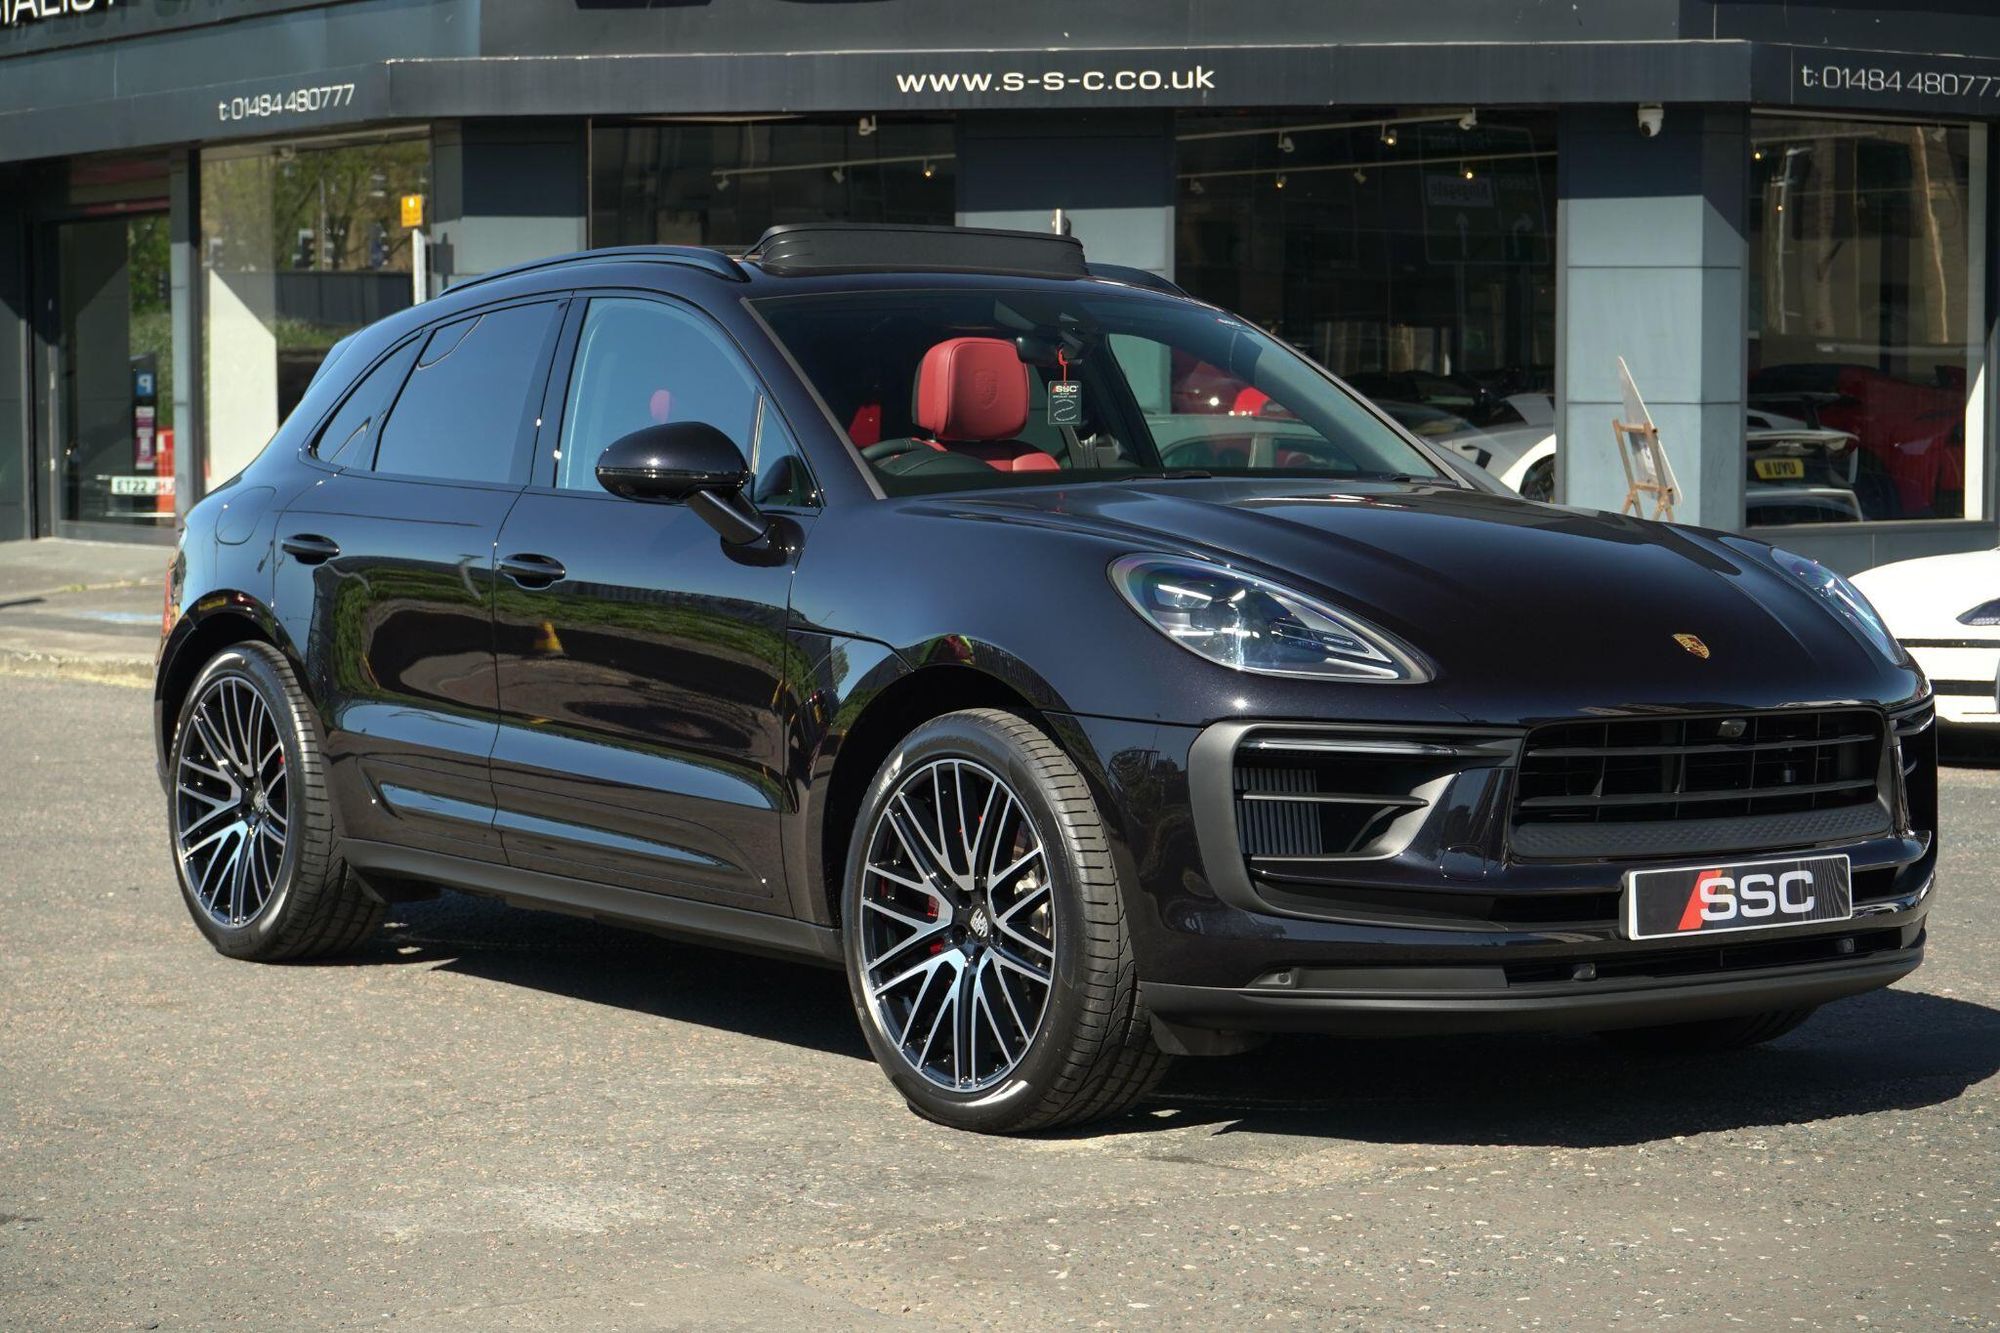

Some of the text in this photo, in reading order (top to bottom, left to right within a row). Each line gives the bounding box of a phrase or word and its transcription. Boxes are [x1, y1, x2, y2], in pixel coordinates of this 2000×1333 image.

[896, 65, 1216, 92] www.s-s-c.co.uk
[284, 83, 356, 112] 480777
[1699, 870, 1815, 921] SSC
